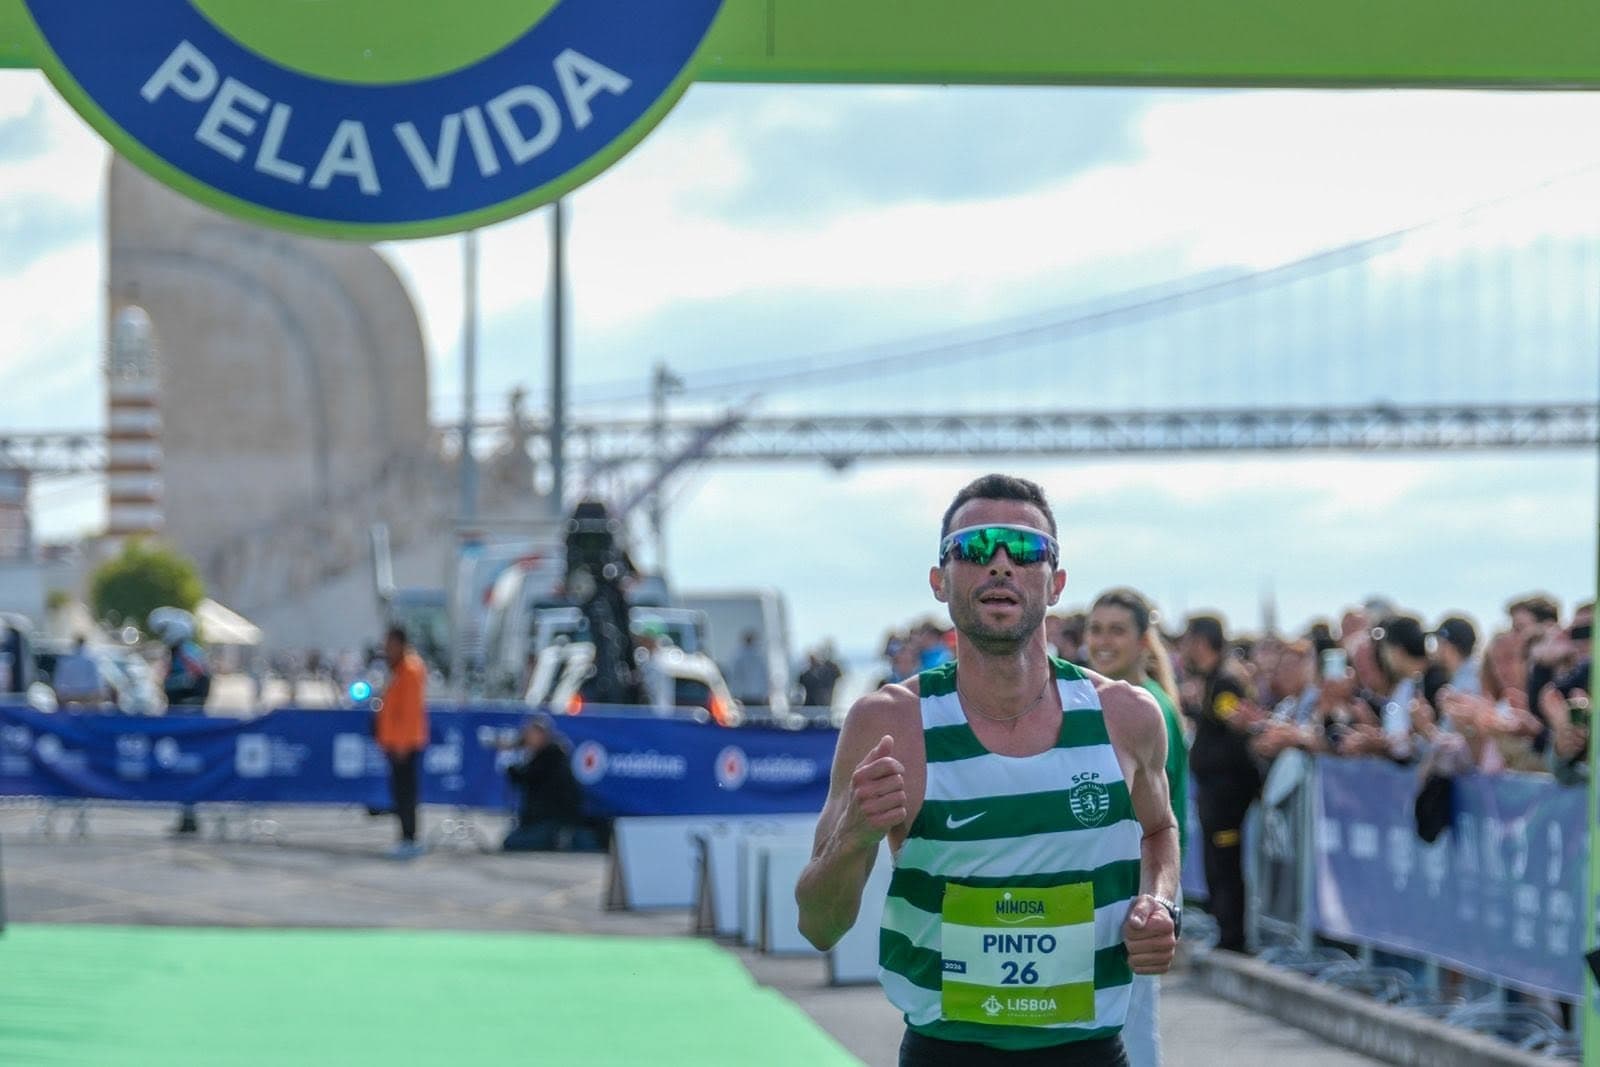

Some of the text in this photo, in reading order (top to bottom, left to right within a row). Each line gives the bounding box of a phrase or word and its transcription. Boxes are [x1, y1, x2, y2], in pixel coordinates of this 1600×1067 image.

[140, 40, 632, 195] PELA VIDA
[1071, 771, 1100, 784] SCP
[995, 900, 1045, 914] MIMOSA
[983, 934, 1057, 953] PINTO
[945, 962, 962, 970] 2026
[1000, 961, 1039, 985] 26
[1007, 998, 1057, 1011] LISBOA
